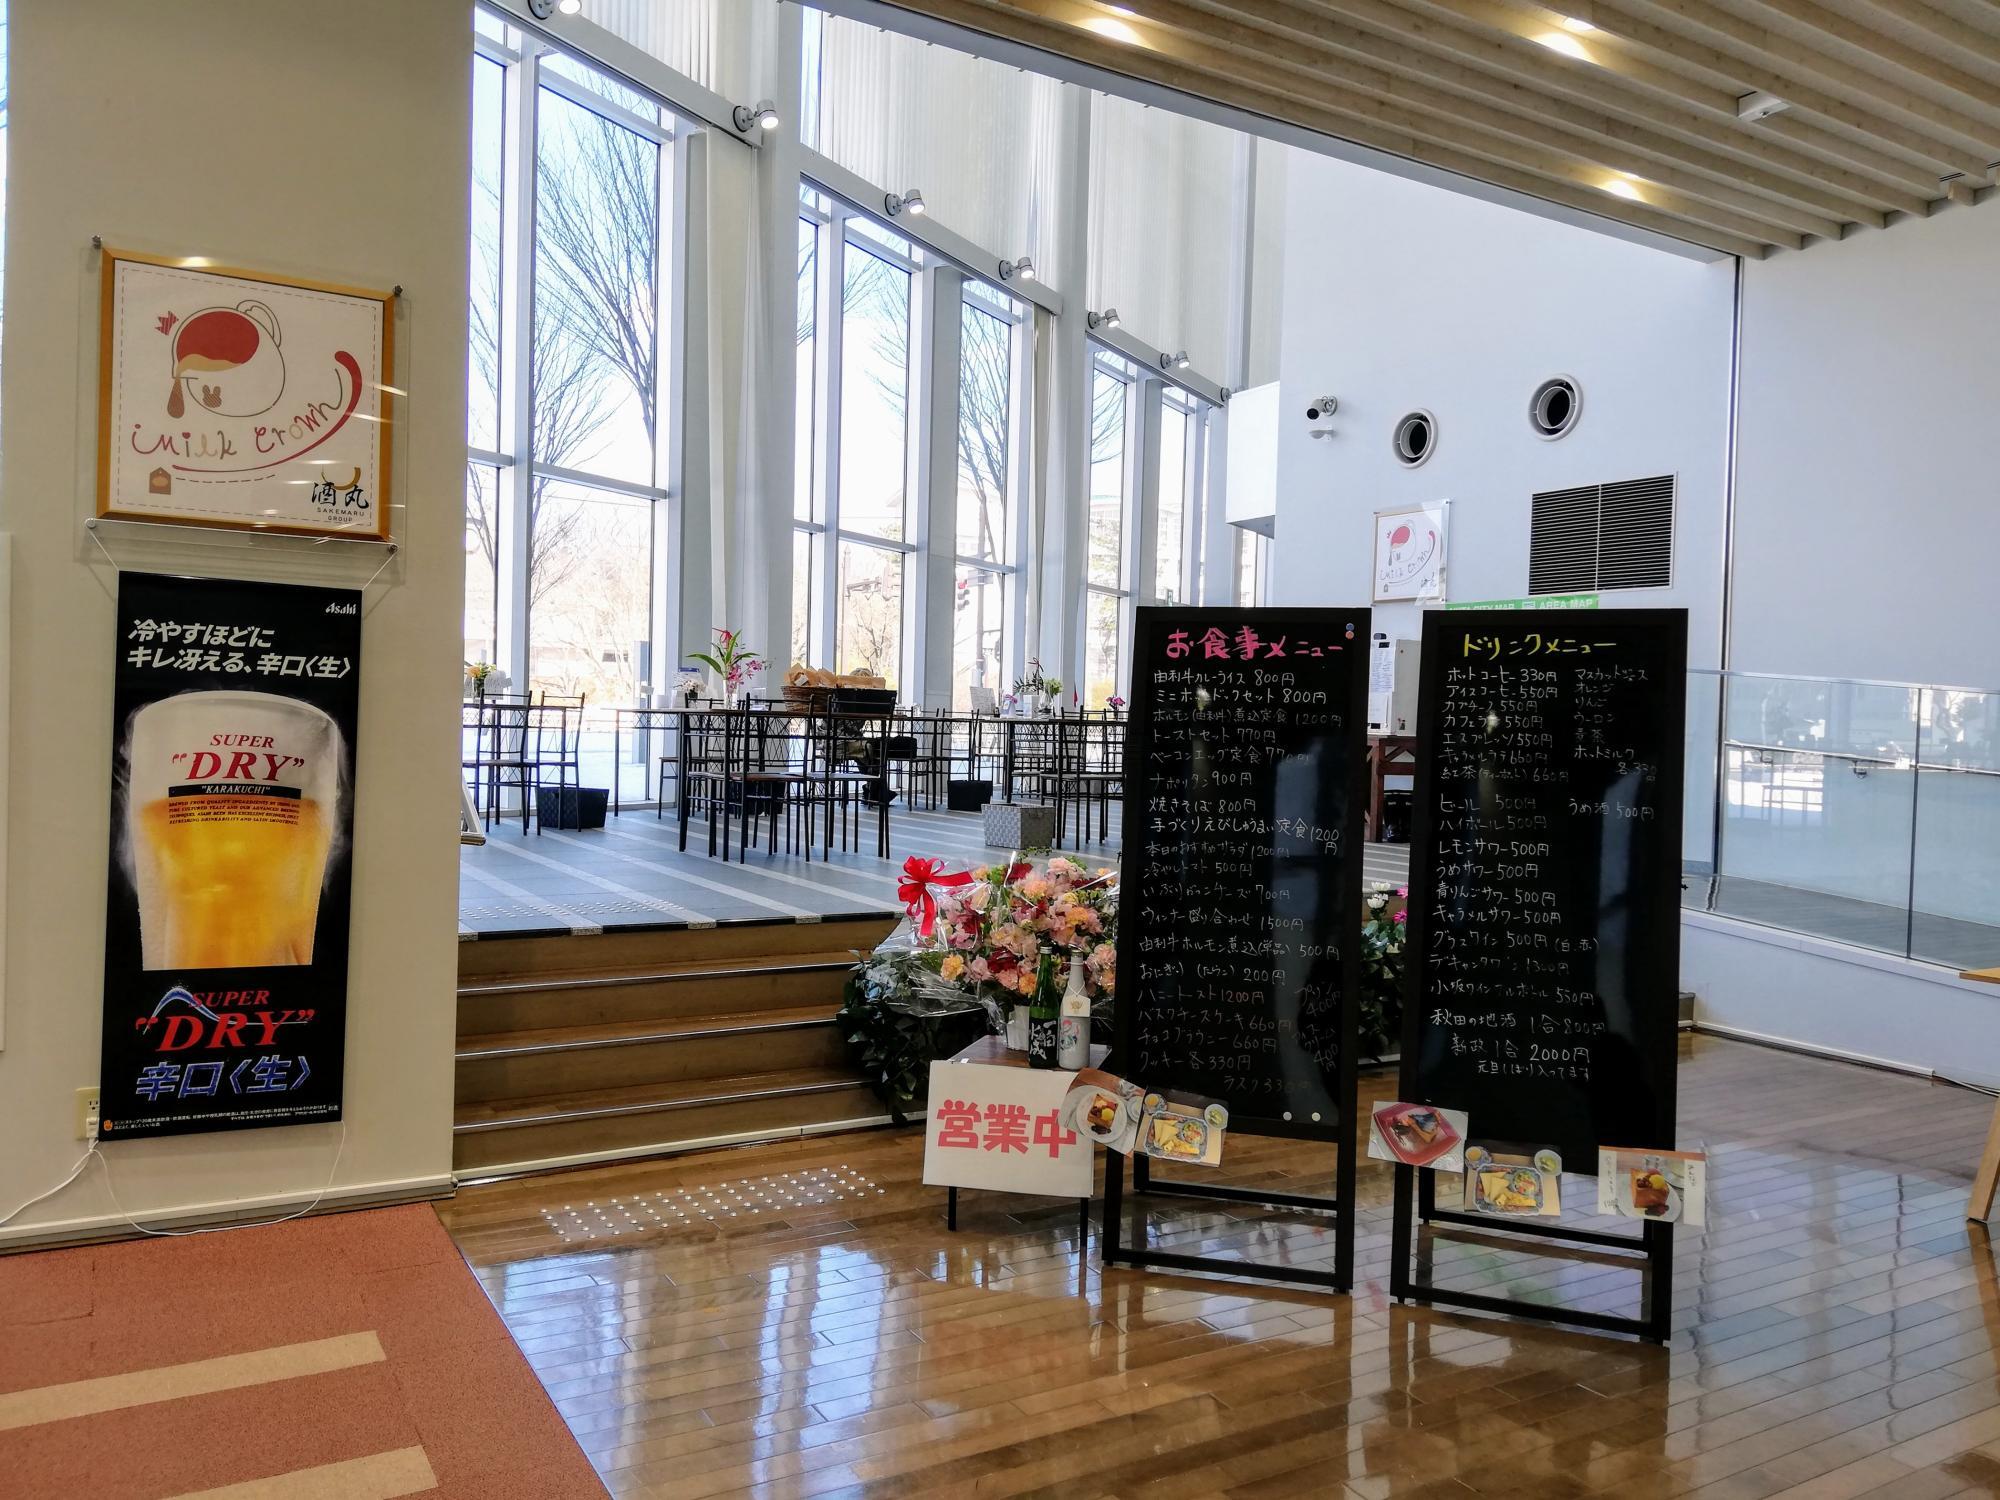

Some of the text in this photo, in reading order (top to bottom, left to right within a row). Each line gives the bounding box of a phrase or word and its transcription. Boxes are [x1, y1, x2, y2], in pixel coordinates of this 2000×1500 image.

[312, 482, 369, 508] 酒丸
[317, 508, 364, 516] SAKEMARU
[325, 602, 356, 615] Asahi
[1570, 598, 1593, 608] MAP
[128, 618, 275, 648] 冷やすほどに
[1166, 625, 1344, 660] お食事メニュー
[1464, 633, 1617, 660] ドリンクメニュー
[1254, 669, 1295, 686] 800円
[1448, 665, 1557, 684] ホットコーヒー 330円
[1282, 688, 1327, 704] 800円
[1446, 682, 1558, 698] アイスコーヒー 550円
[1442, 700, 1538, 713] カプチーノ 550円
[1444, 715, 1543, 728] カフェラ 550円
[210, 734, 274, 749] SUPER
[1154, 727, 1276, 744] トーストセット 770円
[1443, 732, 1552, 748] エスプレッソ 550円
[1150, 746, 1261, 764] ベーコンエッグ定食
[1574, 745, 1634, 759] ホットミルク
[1149, 770, 1252, 790] ナポリタン 900円
[1148, 796, 1256, 814] 焼きそば 800円
[1440, 793, 1537, 812] ビール 500円
[1568, 798, 1654, 820] うめ酒 500円
[1440, 815, 1548, 831] ハイボール 500円
[1439, 838, 1550, 857] レモンサワー 500円
[1144, 858, 1252, 878] 冷やしトマト 500円
[1436, 860, 1539, 880] うめサワー 500円
[1256, 884, 1290, 904] 700円
[1436, 880, 1556, 906] 青りんごサワー 500円
[1260, 916, 1304, 931] 1500円
[1432, 904, 1561, 925] キャラメルサワー 500円
[1433, 930, 1498, 950] グラスワイン
[1507, 930, 1548, 948] 500円
[1300, 944, 1340, 960] 500円
[1140, 962, 1184, 980] おにぎり
[1244, 968, 1286, 986] 200円
[188, 990, 270, 1008] SUPER
[1222, 988, 1264, 1004] 1200円
[1556, 986, 1595, 1006] 550円
[1249, 1016, 1291, 1032] 660円
[1430, 1008, 1517, 1028] 秋田の地酒
[1138, 1026, 1276, 1053] チョコブラウニー 660円
[1530, 1044, 1590, 1063] 2000円
[936, 1098, 1076, 1159] 営業中
